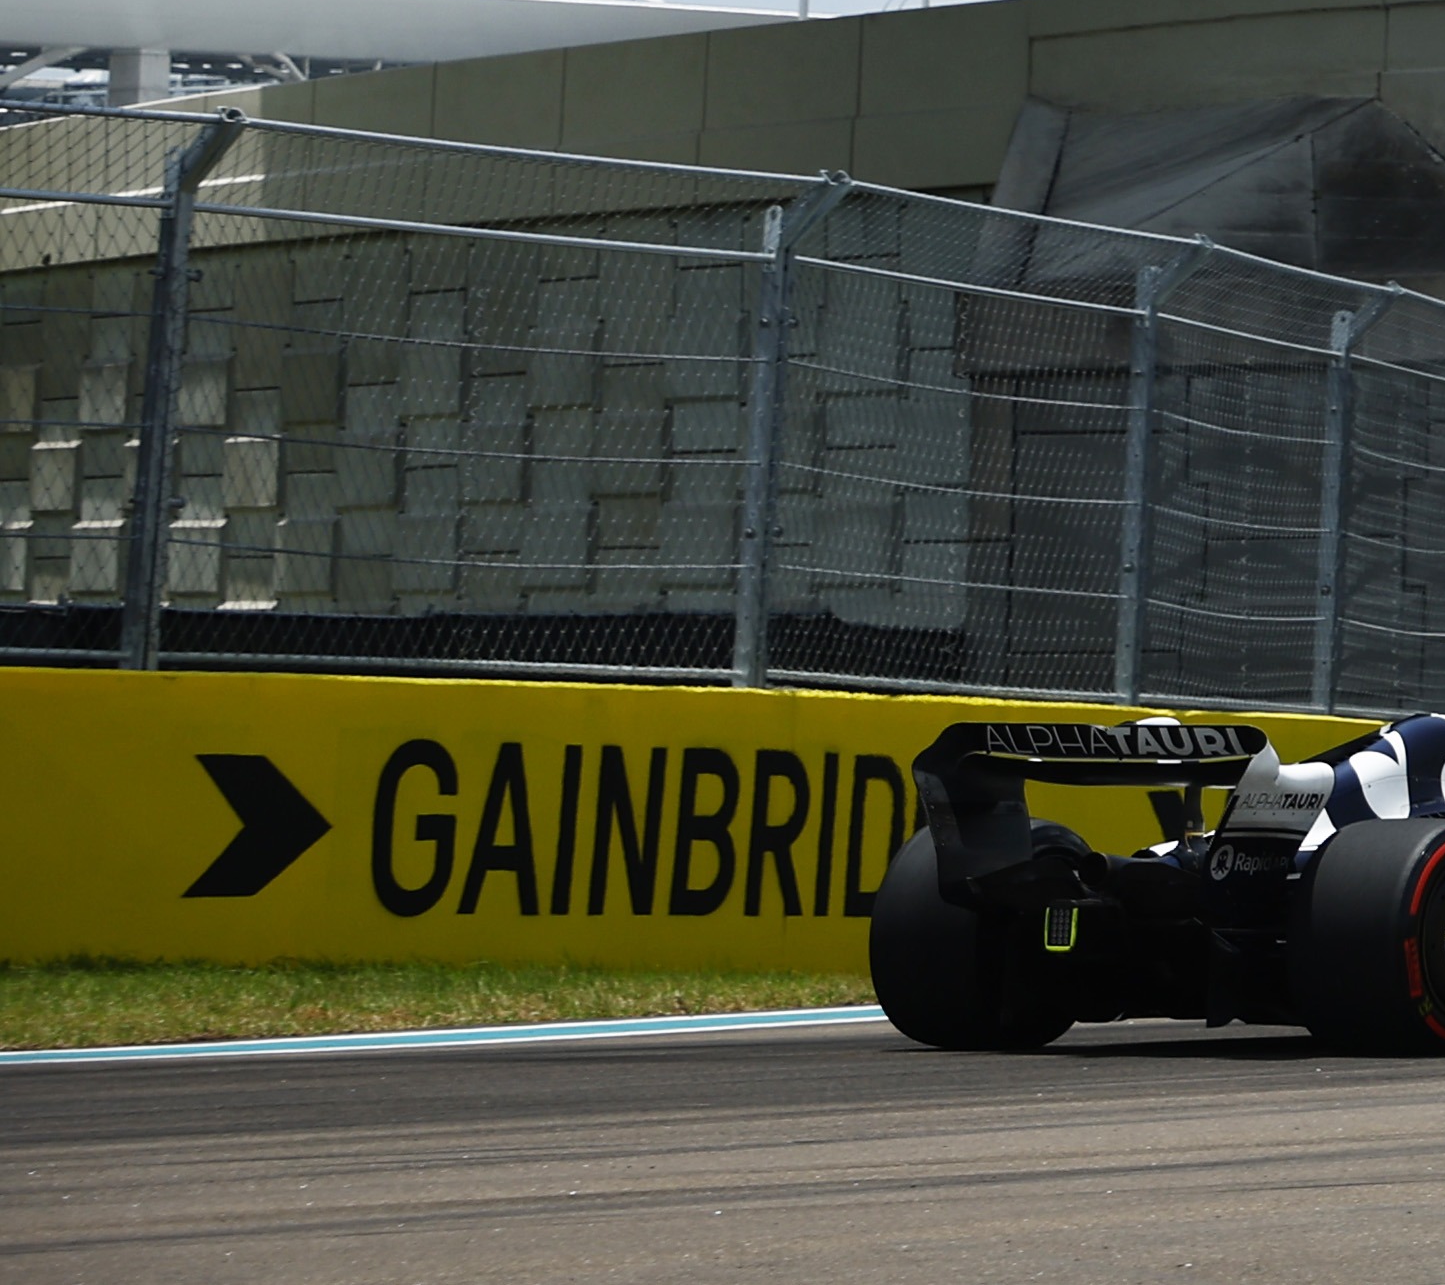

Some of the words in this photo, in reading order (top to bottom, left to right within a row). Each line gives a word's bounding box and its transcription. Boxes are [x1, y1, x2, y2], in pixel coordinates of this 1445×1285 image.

[986, 725, 1246, 756] ALPHATAURI
[1241, 793, 1324, 809] ALPHATAURI
[372, 738, 929, 917] GAINBRID
